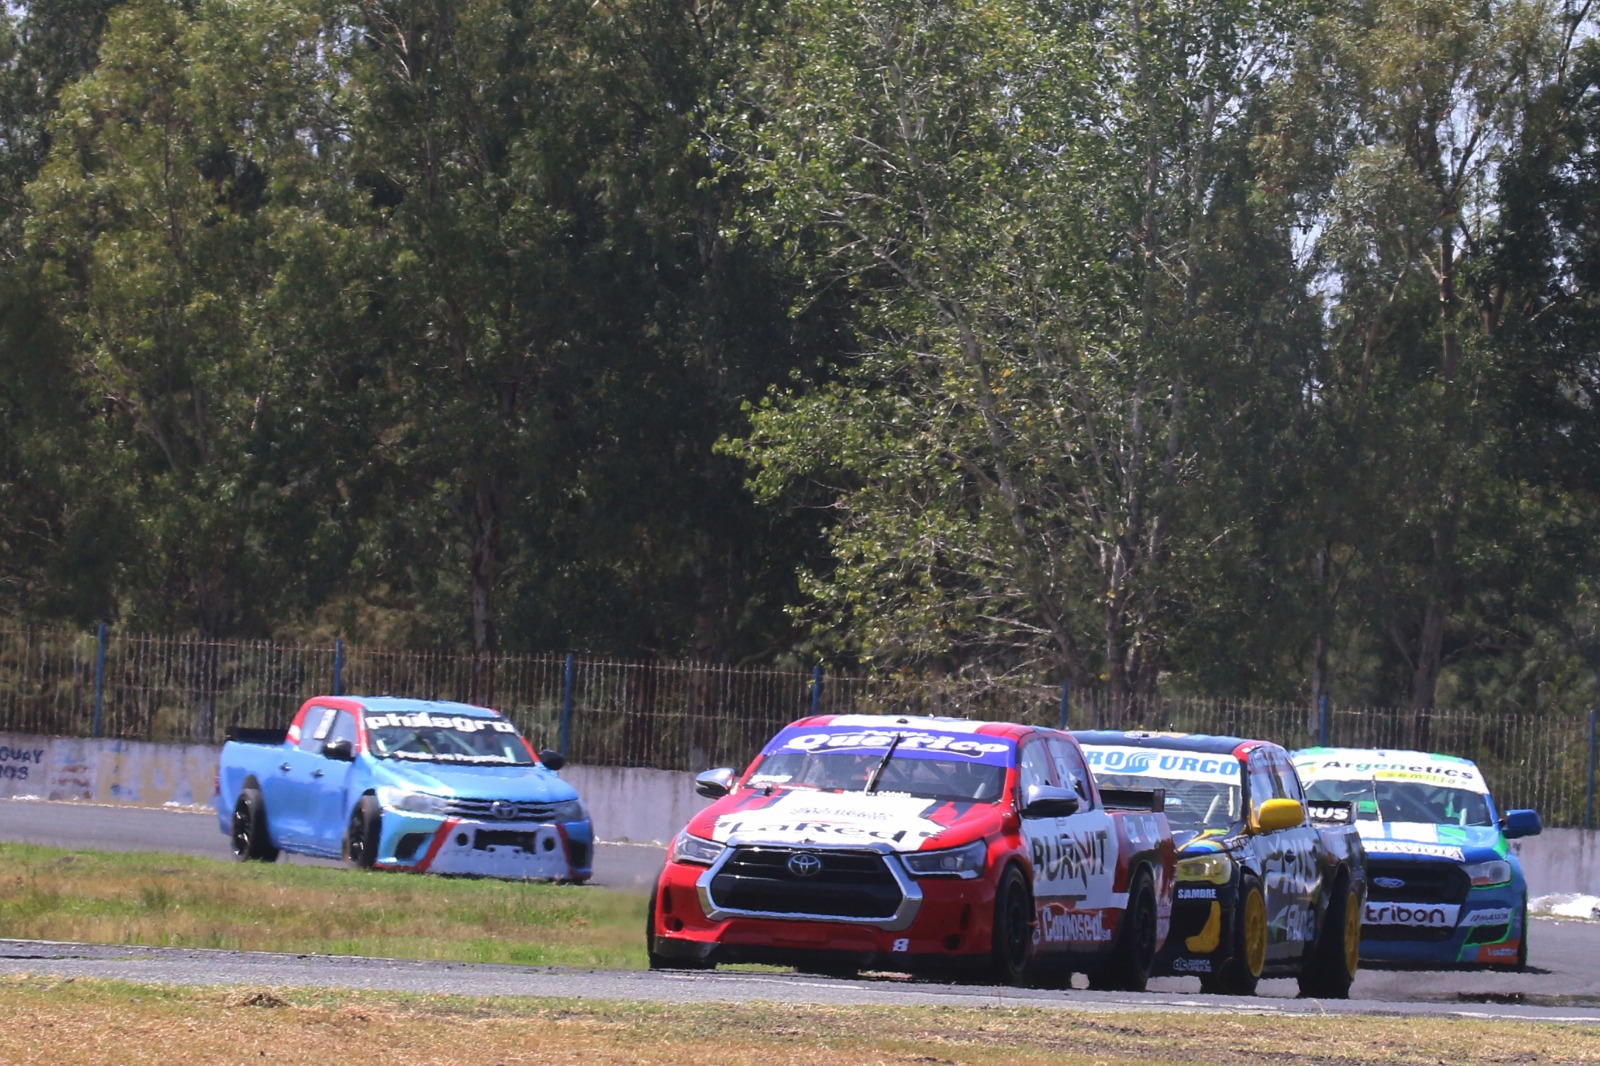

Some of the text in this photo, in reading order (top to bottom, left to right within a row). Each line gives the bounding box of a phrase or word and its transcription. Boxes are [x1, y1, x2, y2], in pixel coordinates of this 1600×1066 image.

[365, 712, 515, 733] philagro
[1158, 754, 1240, 777] URCO
[1322, 760, 1474, 781] Argenetics
[1365, 904, 1446, 923] tribon
